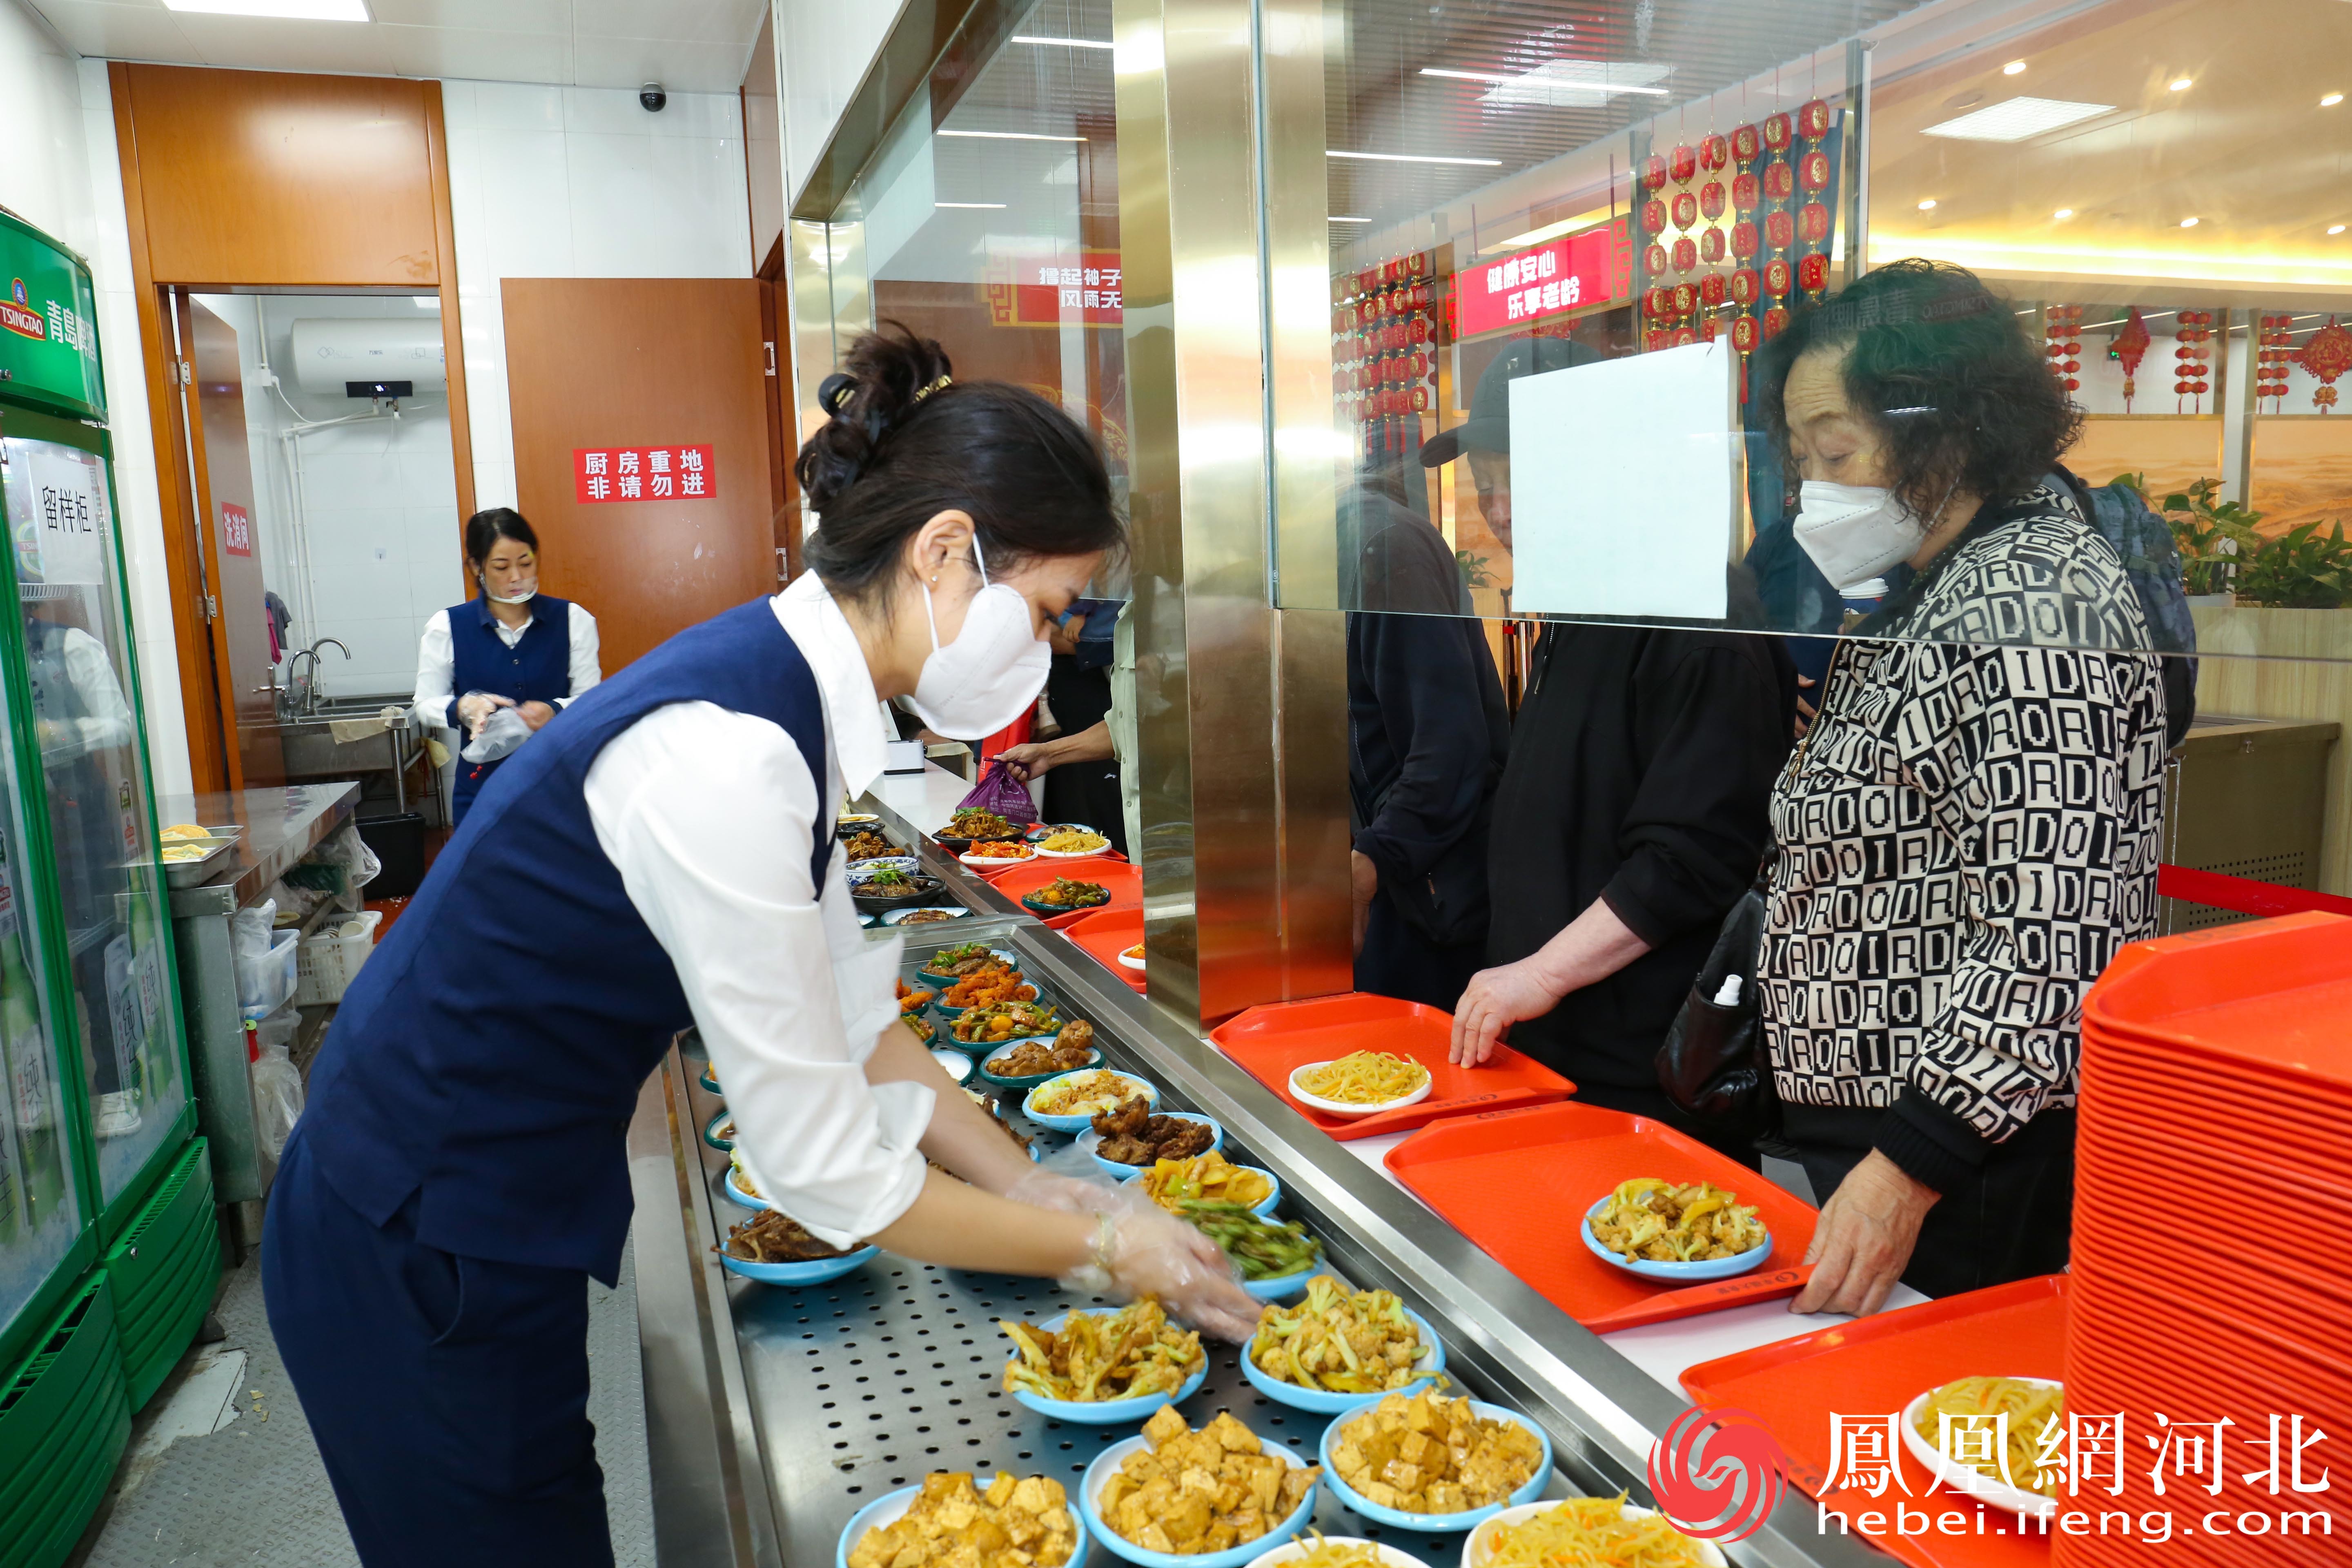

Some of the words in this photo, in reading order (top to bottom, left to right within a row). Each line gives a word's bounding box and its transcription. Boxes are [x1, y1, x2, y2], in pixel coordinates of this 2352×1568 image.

[1039, 267, 1122, 286] 撸起袖子
[1487, 250, 1556, 294] 健康安心
[1508, 276, 1580, 320] 乐享老龄
[0, 306, 43, 336] TSINGTAO
[585, 449, 704, 475] 厨房重地
[587, 473, 705, 499] 非请勿进
[42, 486, 92, 534] 留样柜
[224, 512, 249, 550] 洗消间
